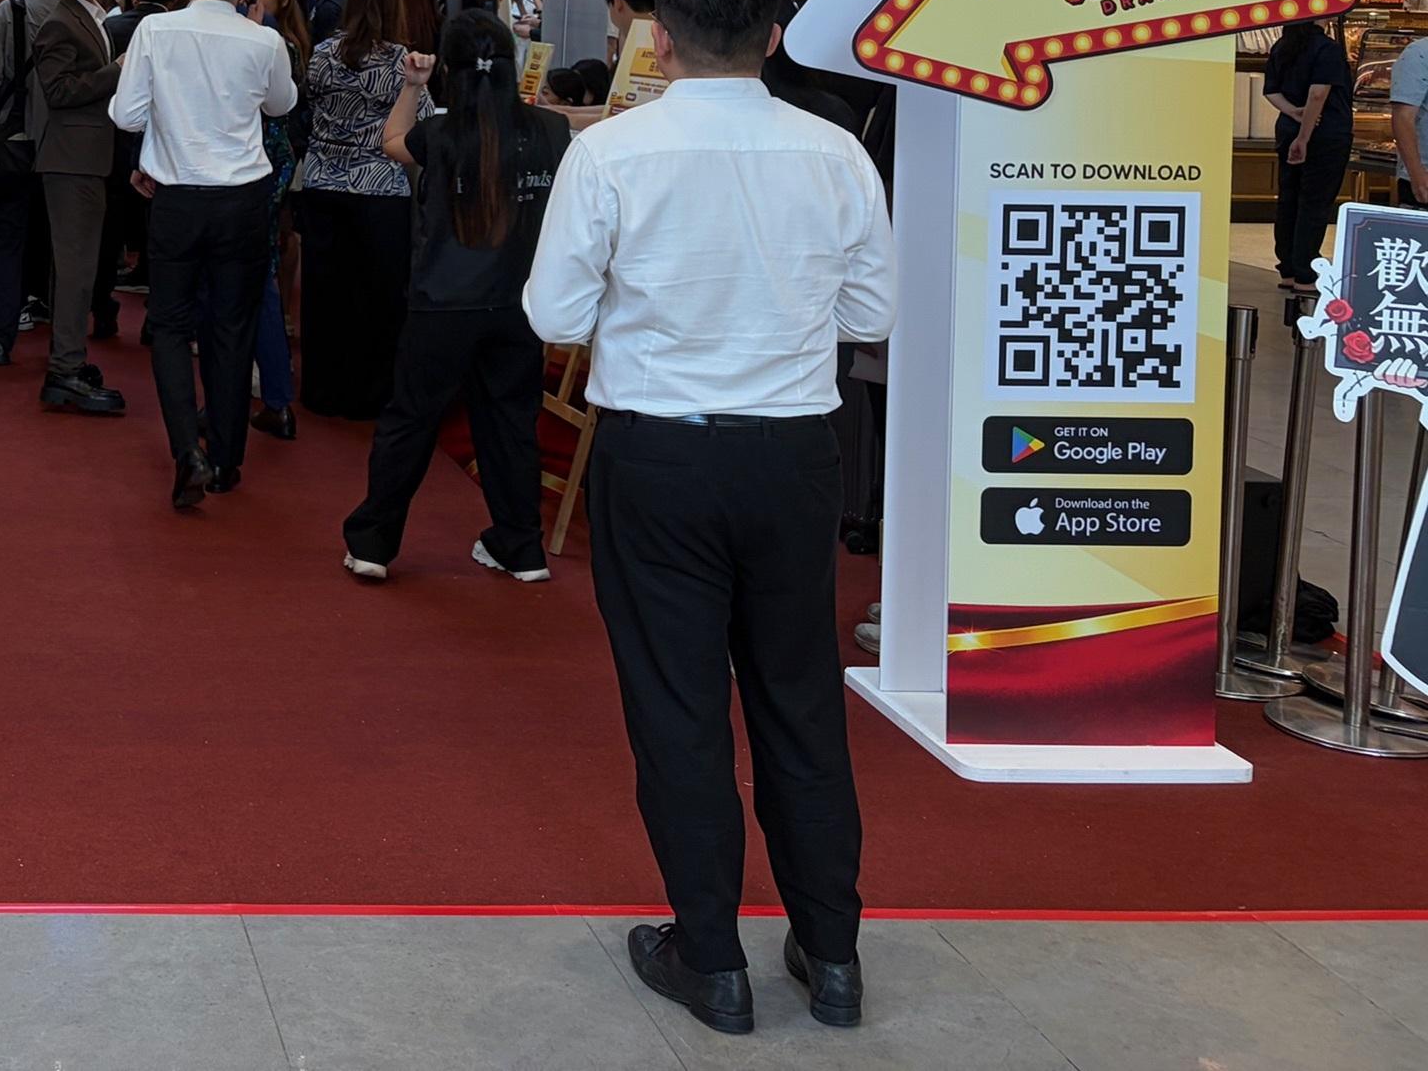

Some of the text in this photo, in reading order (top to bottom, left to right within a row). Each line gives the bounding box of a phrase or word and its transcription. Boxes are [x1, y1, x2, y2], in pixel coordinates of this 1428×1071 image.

[989, 163, 1202, 181] SCAN TO DOWNLOAD
[1054, 427, 1109, 437] GET IT ON
[1053, 441, 1167, 465] Google Play
[1055, 497, 1150, 510] Download on the
[1055, 512, 1162, 537] App Store
